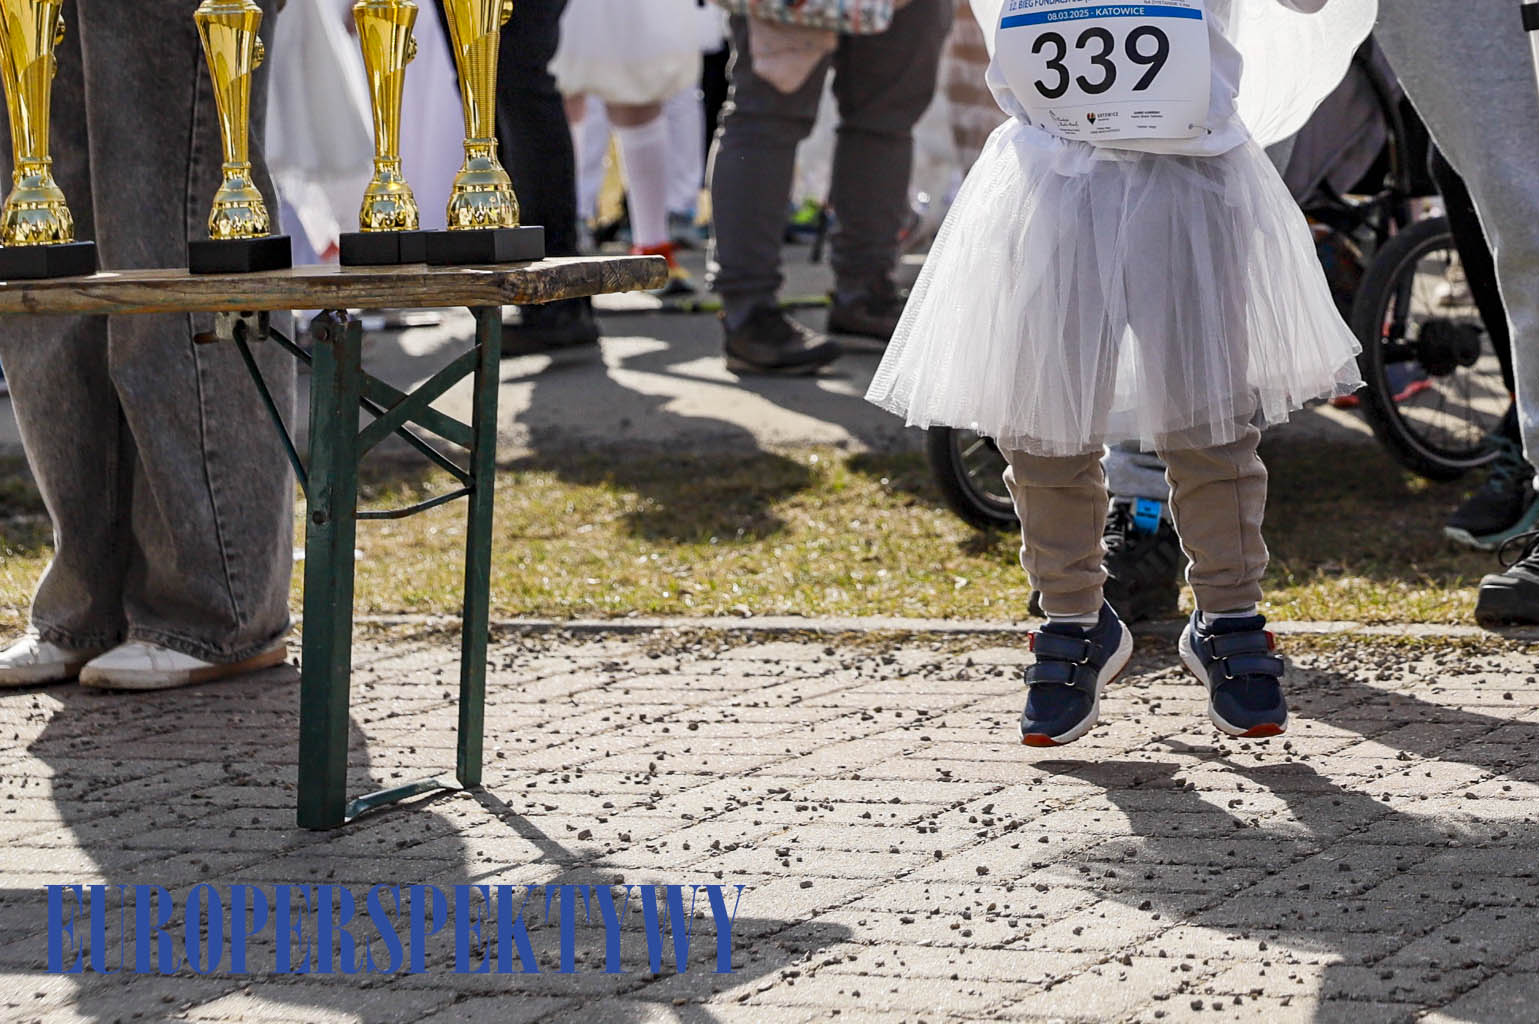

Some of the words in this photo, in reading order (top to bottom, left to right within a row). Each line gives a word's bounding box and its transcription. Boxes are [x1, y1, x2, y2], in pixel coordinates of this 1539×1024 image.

[1047, 9, 1089, 21] 08.03.2025
[1095, 7, 1145, 17] KATOWICE
[1031, 25, 1170, 100] 339
